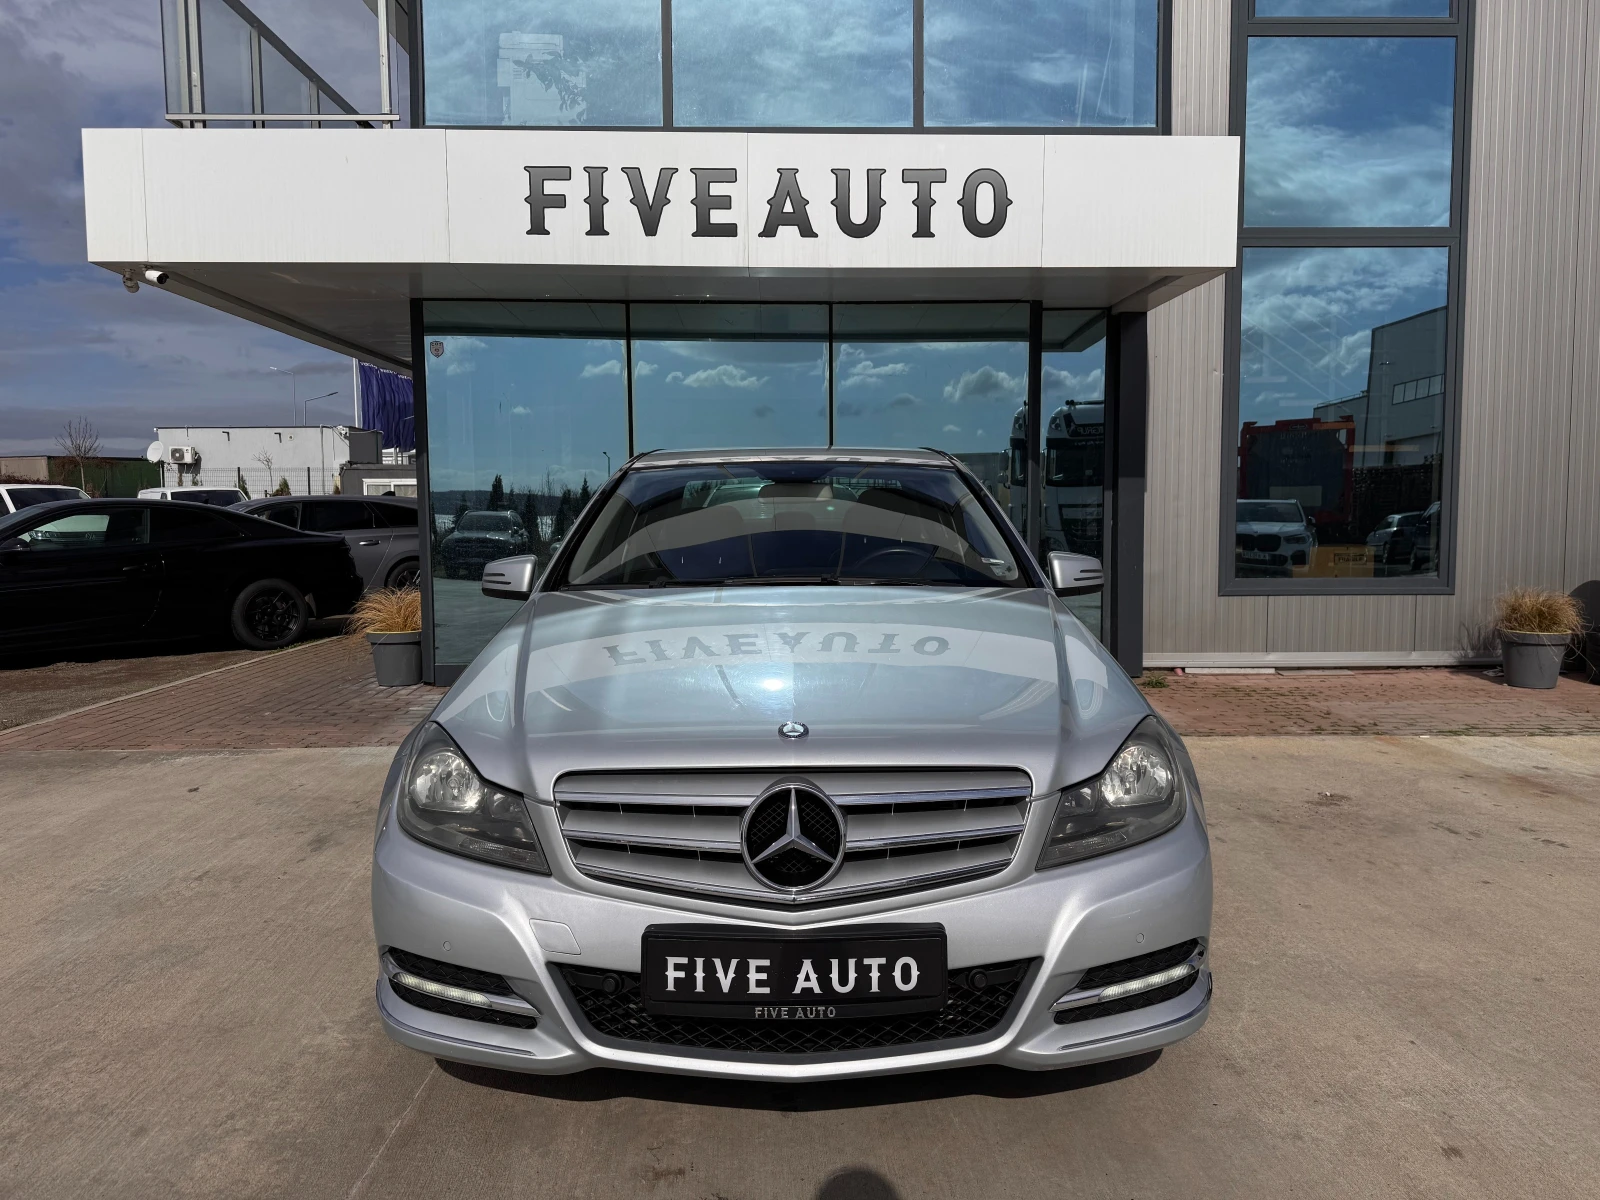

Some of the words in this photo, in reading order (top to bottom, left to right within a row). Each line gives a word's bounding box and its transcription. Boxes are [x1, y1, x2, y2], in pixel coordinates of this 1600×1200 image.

[665, 956, 771, 994] FIVE
[792, 956, 921, 994] AUTO
[754, 1007, 789, 1019] FIVE
[795, 1006, 837, 1018] AUTO
